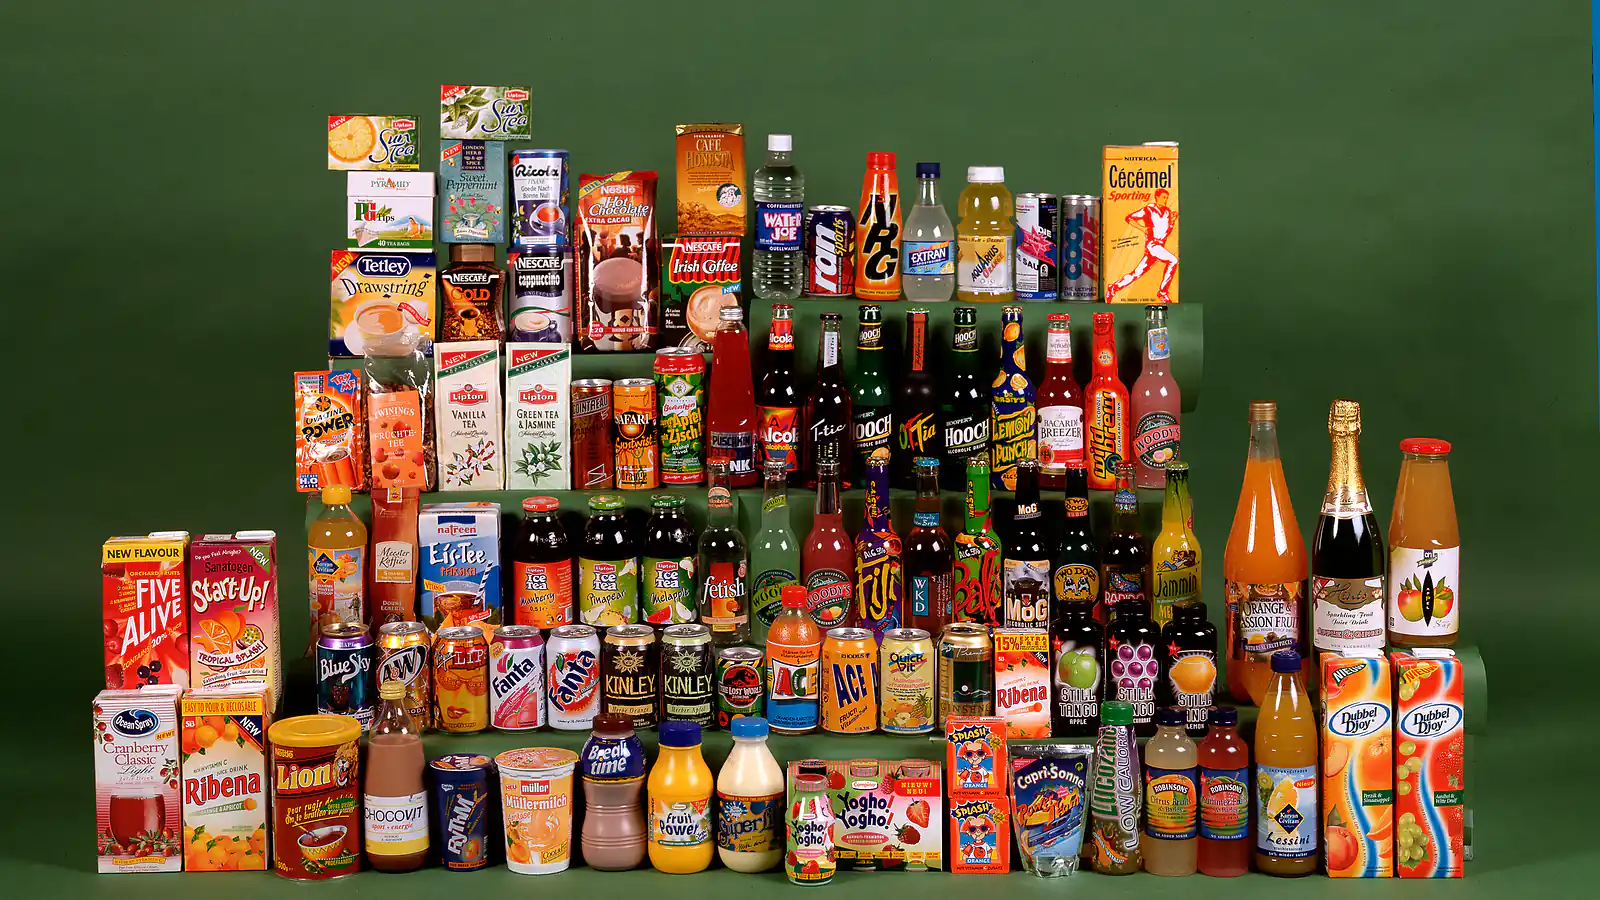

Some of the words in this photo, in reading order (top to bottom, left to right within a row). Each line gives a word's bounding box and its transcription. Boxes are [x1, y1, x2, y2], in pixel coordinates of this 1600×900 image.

[444, 86, 460, 99] NEW
[330, 116, 346, 128] NEW
[460, 172, 486, 182] Sweet
[515, 164, 559, 178] Ricola
[1110, 164, 1172, 189] Cécémel
[446, 180, 498, 192] Peppermint
[1108, 191, 1150, 202] Sporting
[354, 202, 377, 221] PG
[377, 213, 395, 222] Tips
[589, 201, 648, 216] Chocolate
[764, 212, 801, 228] WATER
[771, 227, 797, 240] JOE
[685, 242, 722, 251] NESCAFÉ
[518, 256, 560, 269] NESCAFÉ
[815, 224, 837, 294] ran
[835, 217, 844, 256] sports
[911, 248, 946, 264] EXTRAN
[971, 244, 999, 282] AQUARIUS
[333, 253, 354, 274] NEW
[362, 258, 408, 274] Tetley
[674, 258, 700, 273] Irish
[702, 259, 737, 273] Coffee
[453, 273, 488, 282] NESCAFÉ
[519, 273, 560, 288] cappuccino
[340, 278, 430, 297] Drawstring
[451, 287, 490, 300] GOLD
[724, 285, 740, 294] NEW
[445, 352, 466, 365] NEW
[515, 351, 538, 363] NEW
[331, 373, 351, 384] TRY
[341, 380, 355, 392] ME
[374, 407, 415, 419] TWININGS
[452, 410, 486, 420] VANILLA
[517, 409, 542, 418] GREEN
[545, 410, 559, 419] TEA
[615, 414, 649, 425] SAFARI
[302, 413, 355, 442] POWER
[525, 420, 556, 429] JASMINE
[811, 418, 846, 441] T-tic
[992, 412, 1032, 441] LEMON
[1043, 419, 1079, 428] BACARDI
[945, 418, 989, 446] HOOCH
[1041, 427, 1081, 438] BREEZER
[1135, 425, 1180, 452] WOODY'S
[615, 435, 653, 453] Suntwist
[993, 442, 1028, 464] PUNCH
[1018, 503, 1037, 514] MoG
[437, 524, 477, 537] natreen
[107, 550, 131, 558] NEW
[135, 548, 180, 558] FLAVOUR
[250, 547, 269, 566] NEW
[205, 561, 253, 574] Sanatogen
[1056, 568, 1072, 582] TWO
[1074, 567, 1096, 581] DOGS
[527, 574, 547, 583] Ice
[595, 573, 616, 583] Ice
[658, 571, 678, 580] Ice
[526, 581, 548, 590] Tea
[593, 581, 618, 590] Tea
[656, 579, 680, 588] Tea
[701, 575, 745, 604] fetish
[137, 579, 181, 608] FIVE
[192, 576, 270, 612] Start-Up!
[587, 590, 627, 606] Pinapear
[805, 582, 851, 608] WOODY'S
[1006, 597, 1048, 622] MoG
[121, 598, 182, 656] ALIVE
[995, 637, 1020, 651] 15%
[200, 653, 234, 665] TROPICAL
[236, 643, 263, 662] SPLASH
[890, 652, 924, 662] Quick
[492, 657, 535, 699] Fanta
[1334, 663, 1367, 682] NIEUW
[1405, 664, 1439, 684] NIEUW
[549, 650, 596, 712] Fanta
[606, 674, 655, 695] KINLEY
[664, 674, 712, 695] KINLEY
[775, 667, 817, 696] ACE
[833, 664, 867, 708] ACE
[998, 686, 1048, 708] Ribena
[1061, 688, 1096, 702] STILL
[1118, 688, 1153, 702] STILL
[1178, 694, 1212, 707] STILL
[185, 702, 197, 712] EASY
[198, 702, 205, 711] TO
[205, 702, 219, 711] POUR
[220, 702, 225, 711] &
[226, 702, 256, 711] RECLOSABLE
[1059, 703, 1097, 717] TANGO
[116, 716, 134, 729] Ocean
[134, 718, 153, 731] Spray
[1341, 708, 1378, 727] Dubbel
[1413, 708, 1450, 727] Dubbel
[239, 716, 262, 736] NEW
[1346, 719, 1372, 734] Djoy
[1418, 719, 1444, 734] Djoy
[952, 727, 987, 743] SPLASH
[103, 742, 168, 755] Cranberry
[588, 742, 630, 760] Break
[115, 754, 156, 765] Classic
[590, 757, 626, 775] time
[117, 765, 155, 777] Light
[229, 764, 248, 773] DRINK
[277, 763, 331, 789] Lion
[1017, 763, 1084, 789] Capri-Sonne
[185, 772, 261, 805] Ribena
[522, 782, 549, 793] müller
[1154, 782, 1188, 794] ROBINSONS
[1210, 783, 1243, 794] ROBINSONS
[506, 794, 567, 810] Müllermilch
[837, 791, 895, 813] Yogho!
[364, 806, 423, 822] CHOCOVIT
[955, 803, 990, 818] SPLASH
[666, 813, 692, 824] fruit
[836, 808, 894, 829] Yogho!
[660, 820, 699, 836] Power
[792, 820, 828, 834] Yogho!
[792, 832, 827, 847] Yogho!
[1266, 832, 1310, 845] Lessini
